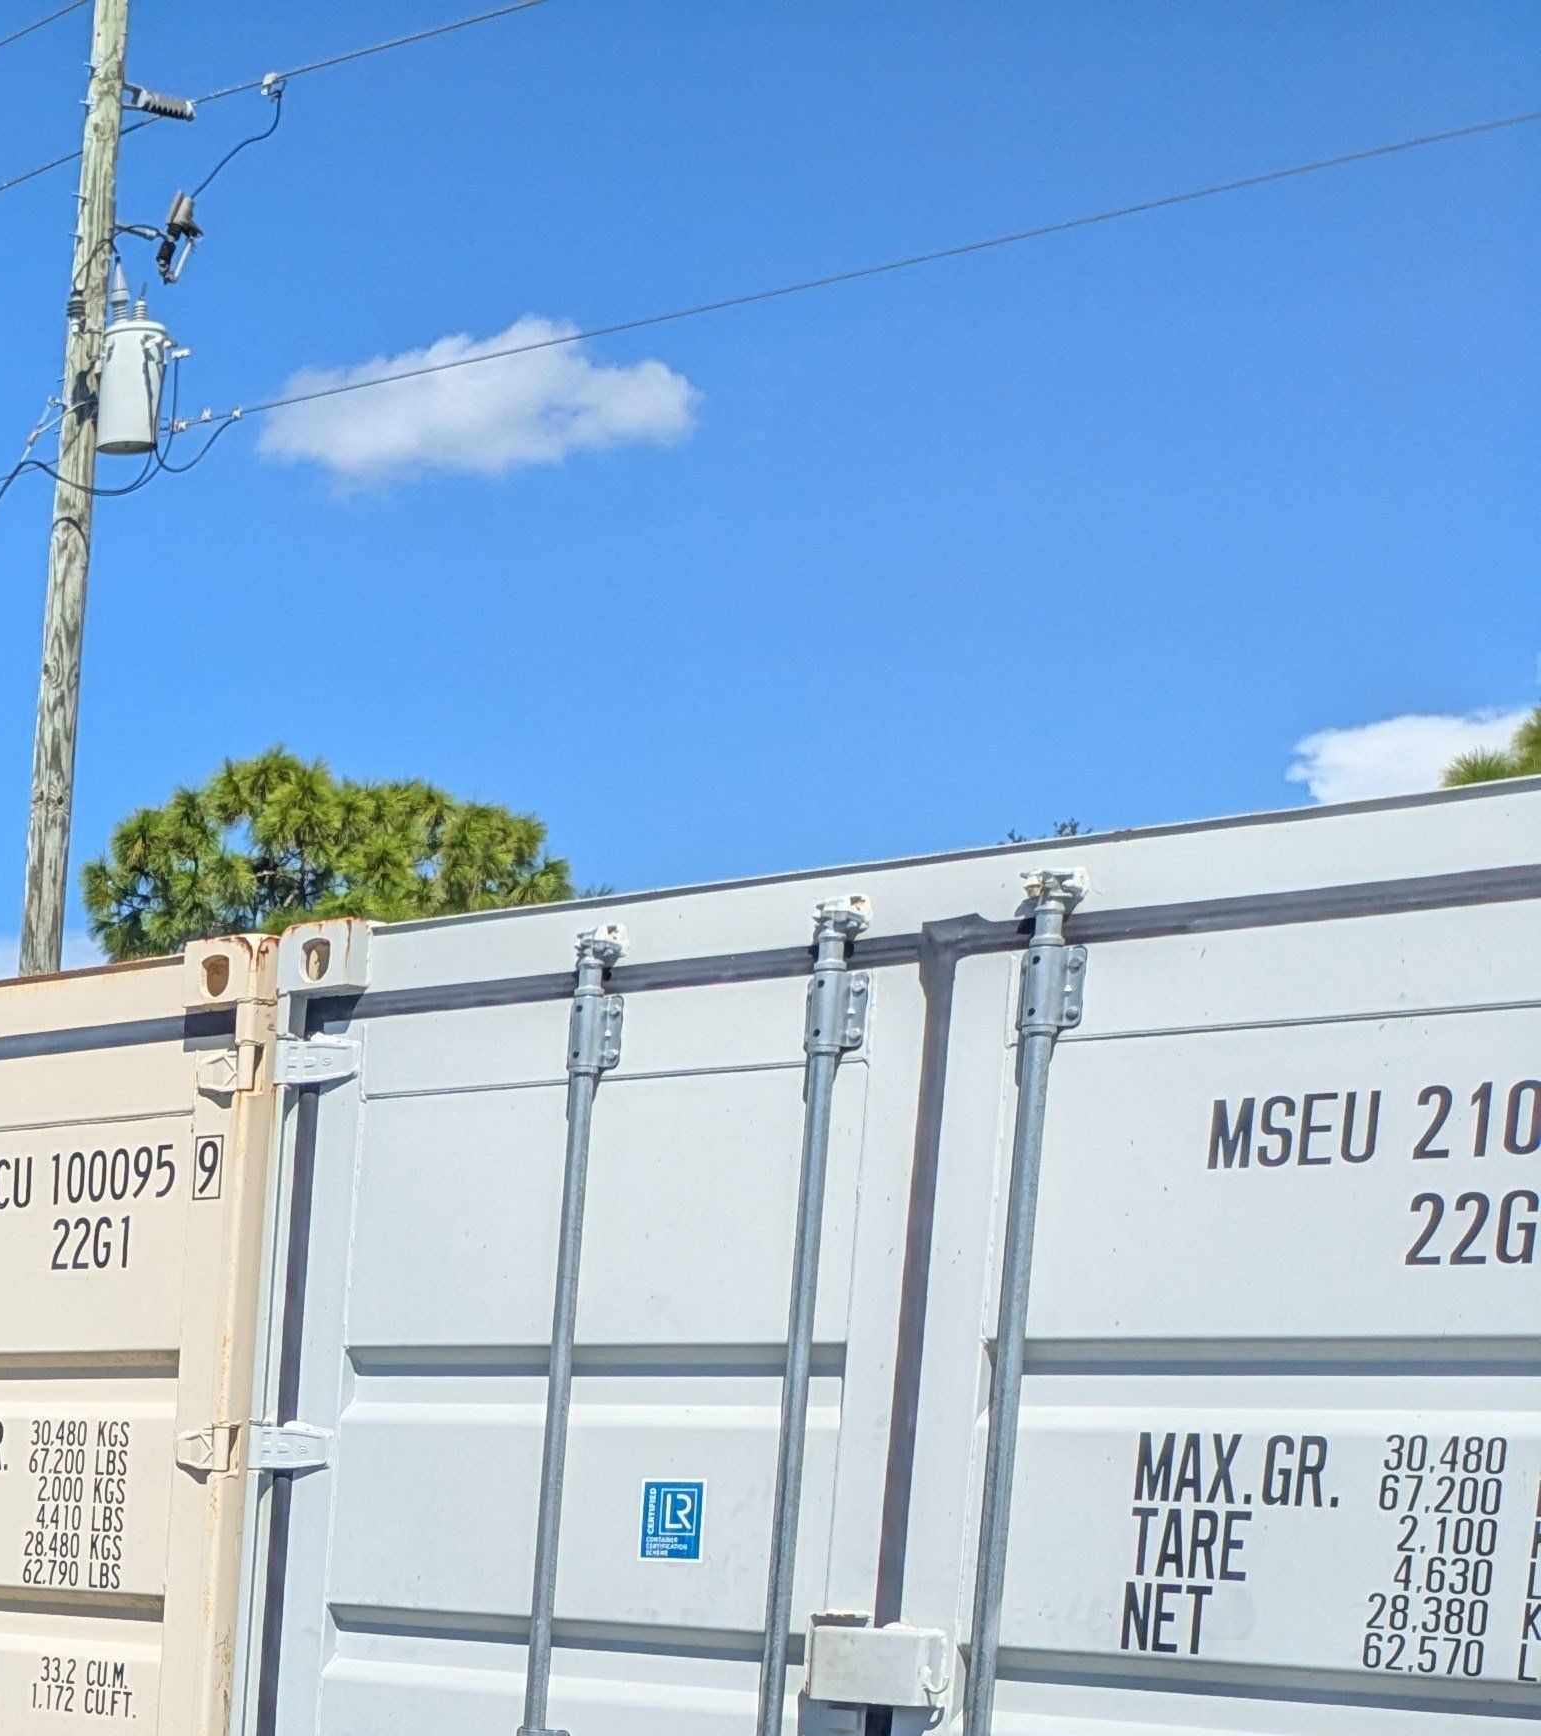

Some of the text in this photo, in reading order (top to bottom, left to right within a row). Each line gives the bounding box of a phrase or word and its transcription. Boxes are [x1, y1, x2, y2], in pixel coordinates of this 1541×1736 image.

[1207, 1079, 1541, 1169] MSEU 210
[51, 1144, 175, 1205] 100095
[198, 1141, 219, 1193] 9
[51, 1216, 131, 1270] 22G1
[1404, 1190, 1540, 1266] 22G
[30, 1421, 130, 1448] 30,480 KGS
[1383, 1434, 1507, 1474] 30,480
[28, 1449, 127, 1476] 67,200 LBS
[37, 1478, 125, 1504] 2,000 KGS
[665, 1493, 692, 1529] LR
[1378, 1475, 1502, 1515] 67,200
[36, 1506, 124, 1532] 4,410 LBS
[1397, 1516, 1497, 1555] 2,100
[24, 1532, 122, 1561] 28,480 KGS
[1132, 1507, 1252, 1581] TARE
[23, 1560, 121, 1589] 62,790 LBS
[1393, 1556, 1492, 1596] 4,630
[1121, 1582, 1213, 1654] NET
[1365, 1594, 1488, 1636] 28,380
[41, 1657, 127, 1689] 33.2 CU.M.
[1362, 1634, 1484, 1677] 62,570
[31, 1683, 136, 1718] 1,172 CU.FT.
